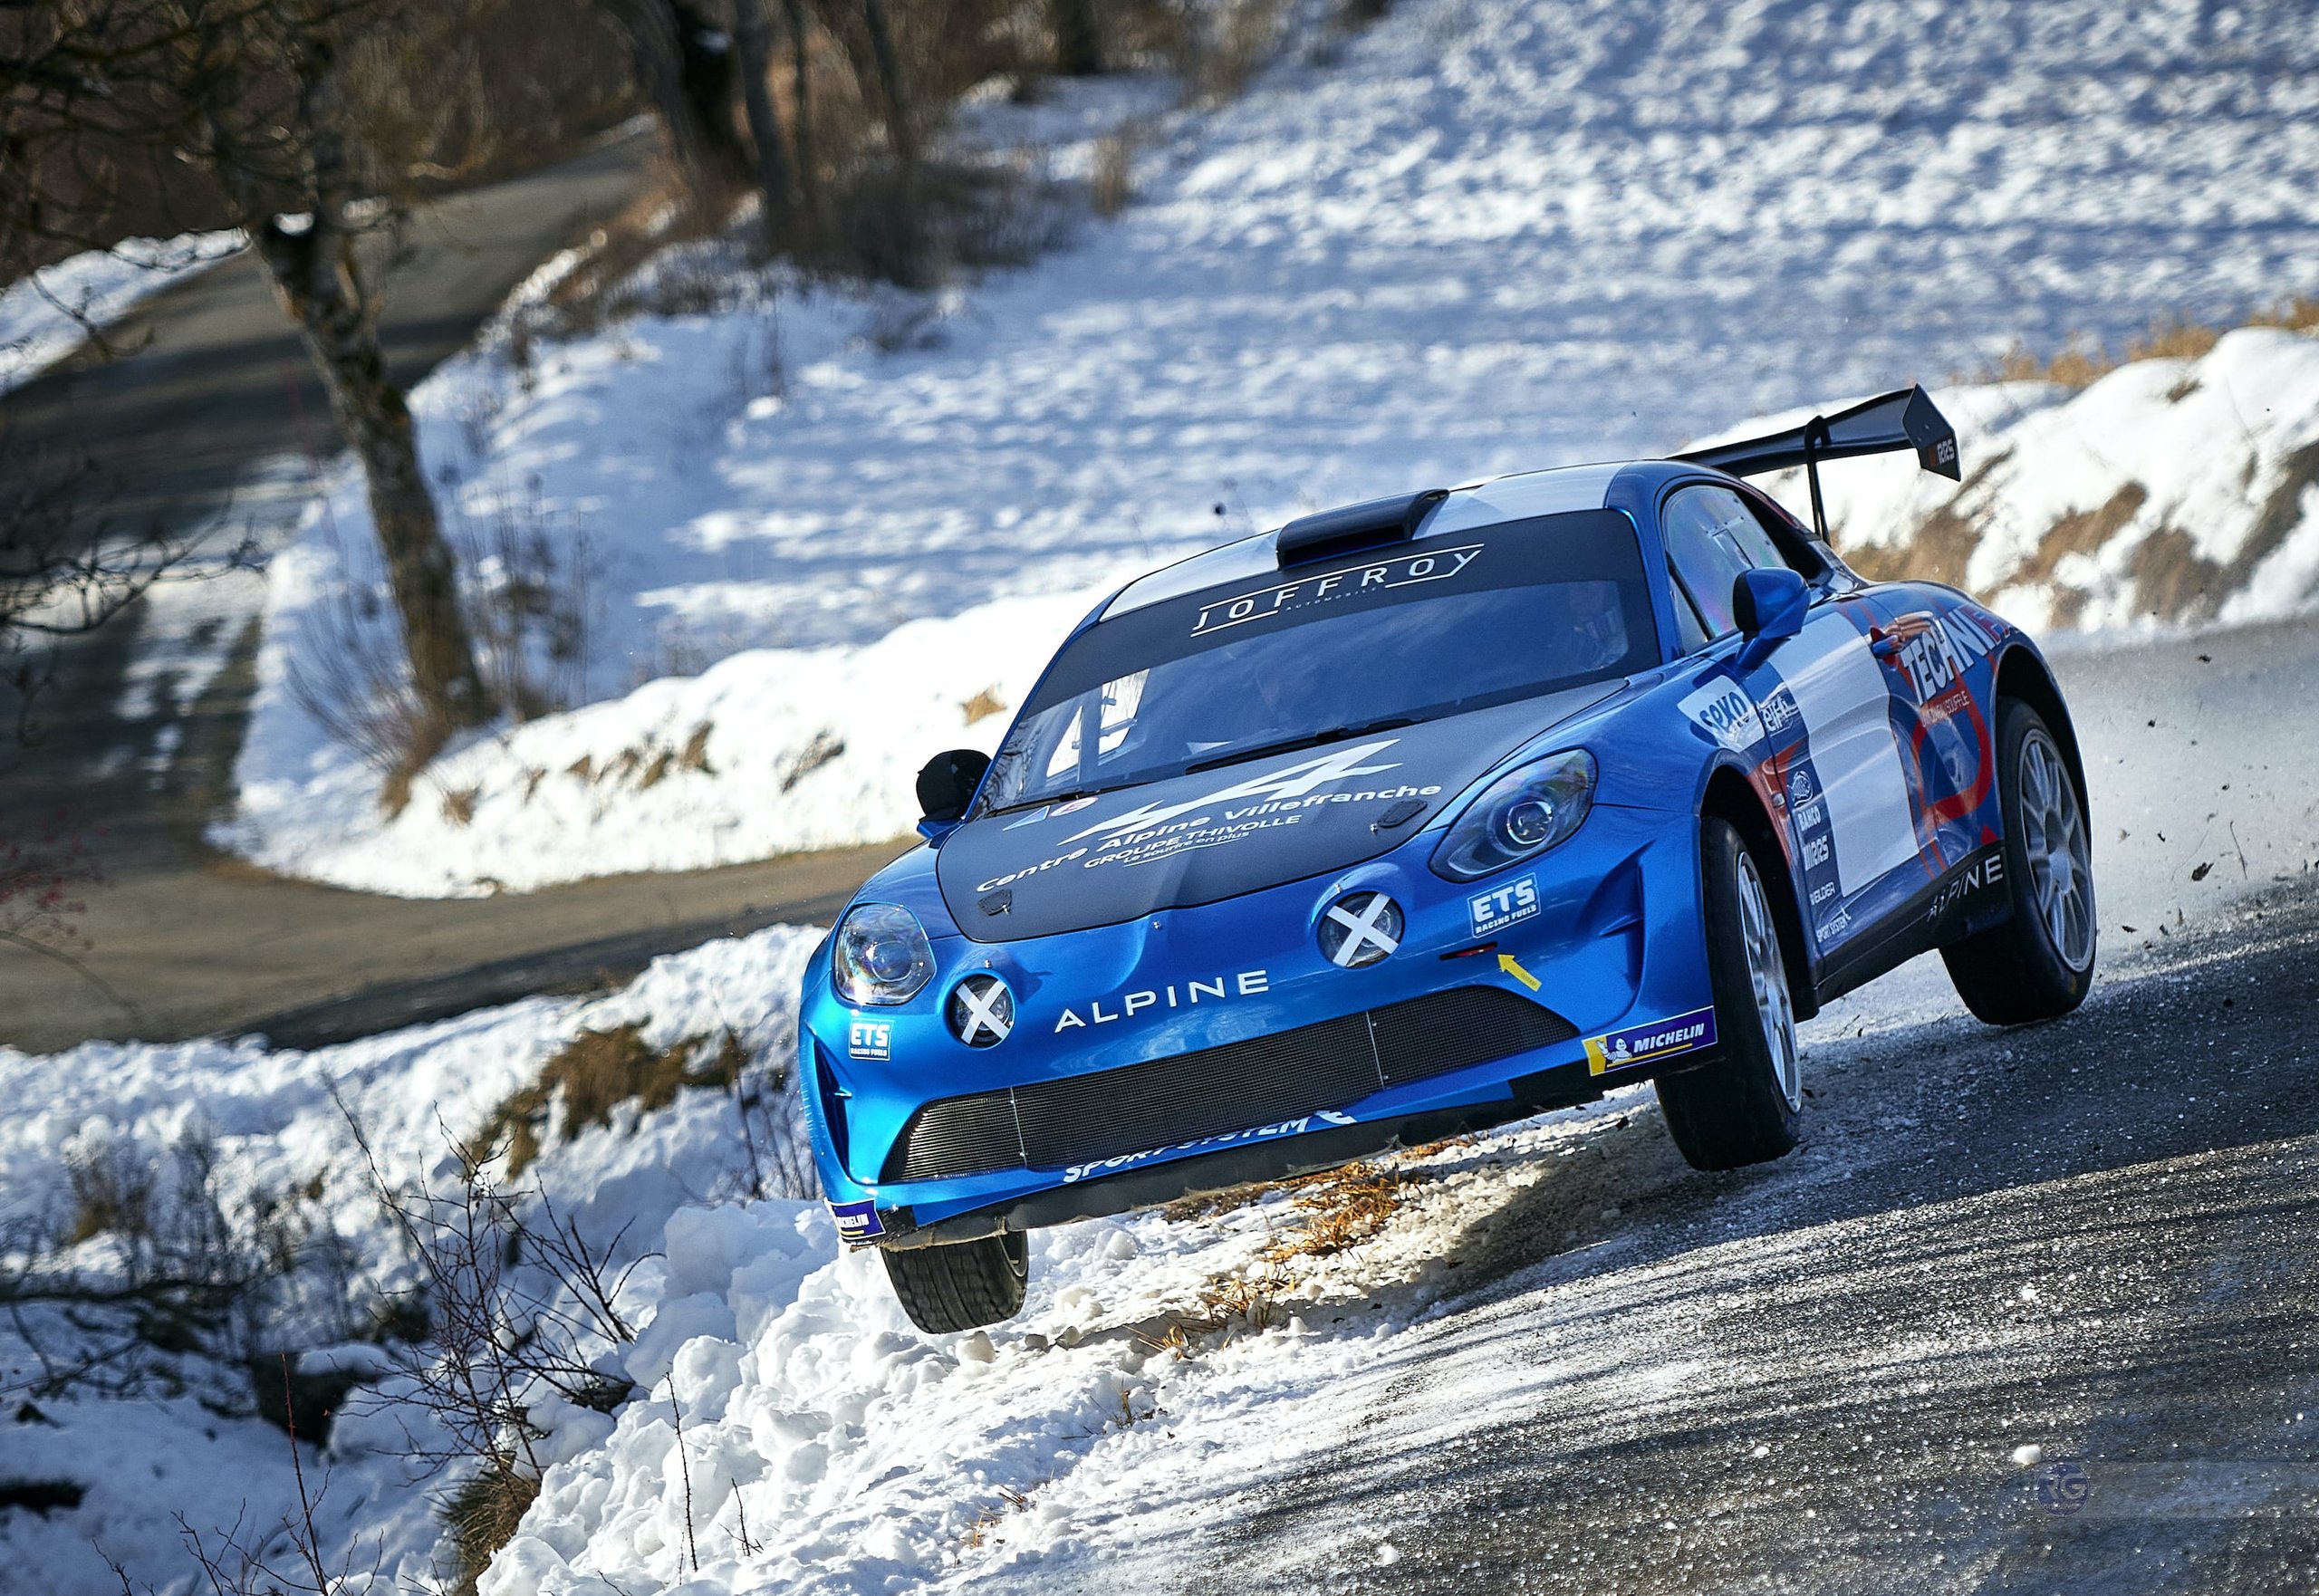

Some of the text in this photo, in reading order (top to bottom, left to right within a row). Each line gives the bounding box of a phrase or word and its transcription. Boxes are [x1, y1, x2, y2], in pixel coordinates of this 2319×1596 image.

[1191, 549, 1483, 631] JOFFROY
[976, 785, 1442, 892] Centre Alpine Villefranche
[1083, 814, 1303, 869] GROUPE THIVOLLE
[1142, 841, 1189, 860] sourire
[1190, 837, 1215, 849] en
[1217, 832, 1250, 845] plus
[1472, 879, 1536, 923] ETS
[1476, 904, 1537, 935] RACING FUELS
[1054, 969, 1269, 1034] ALPINE
[851, 1023, 890, 1047] ETS
[1633, 1023, 1705, 1053] MICHELIN
